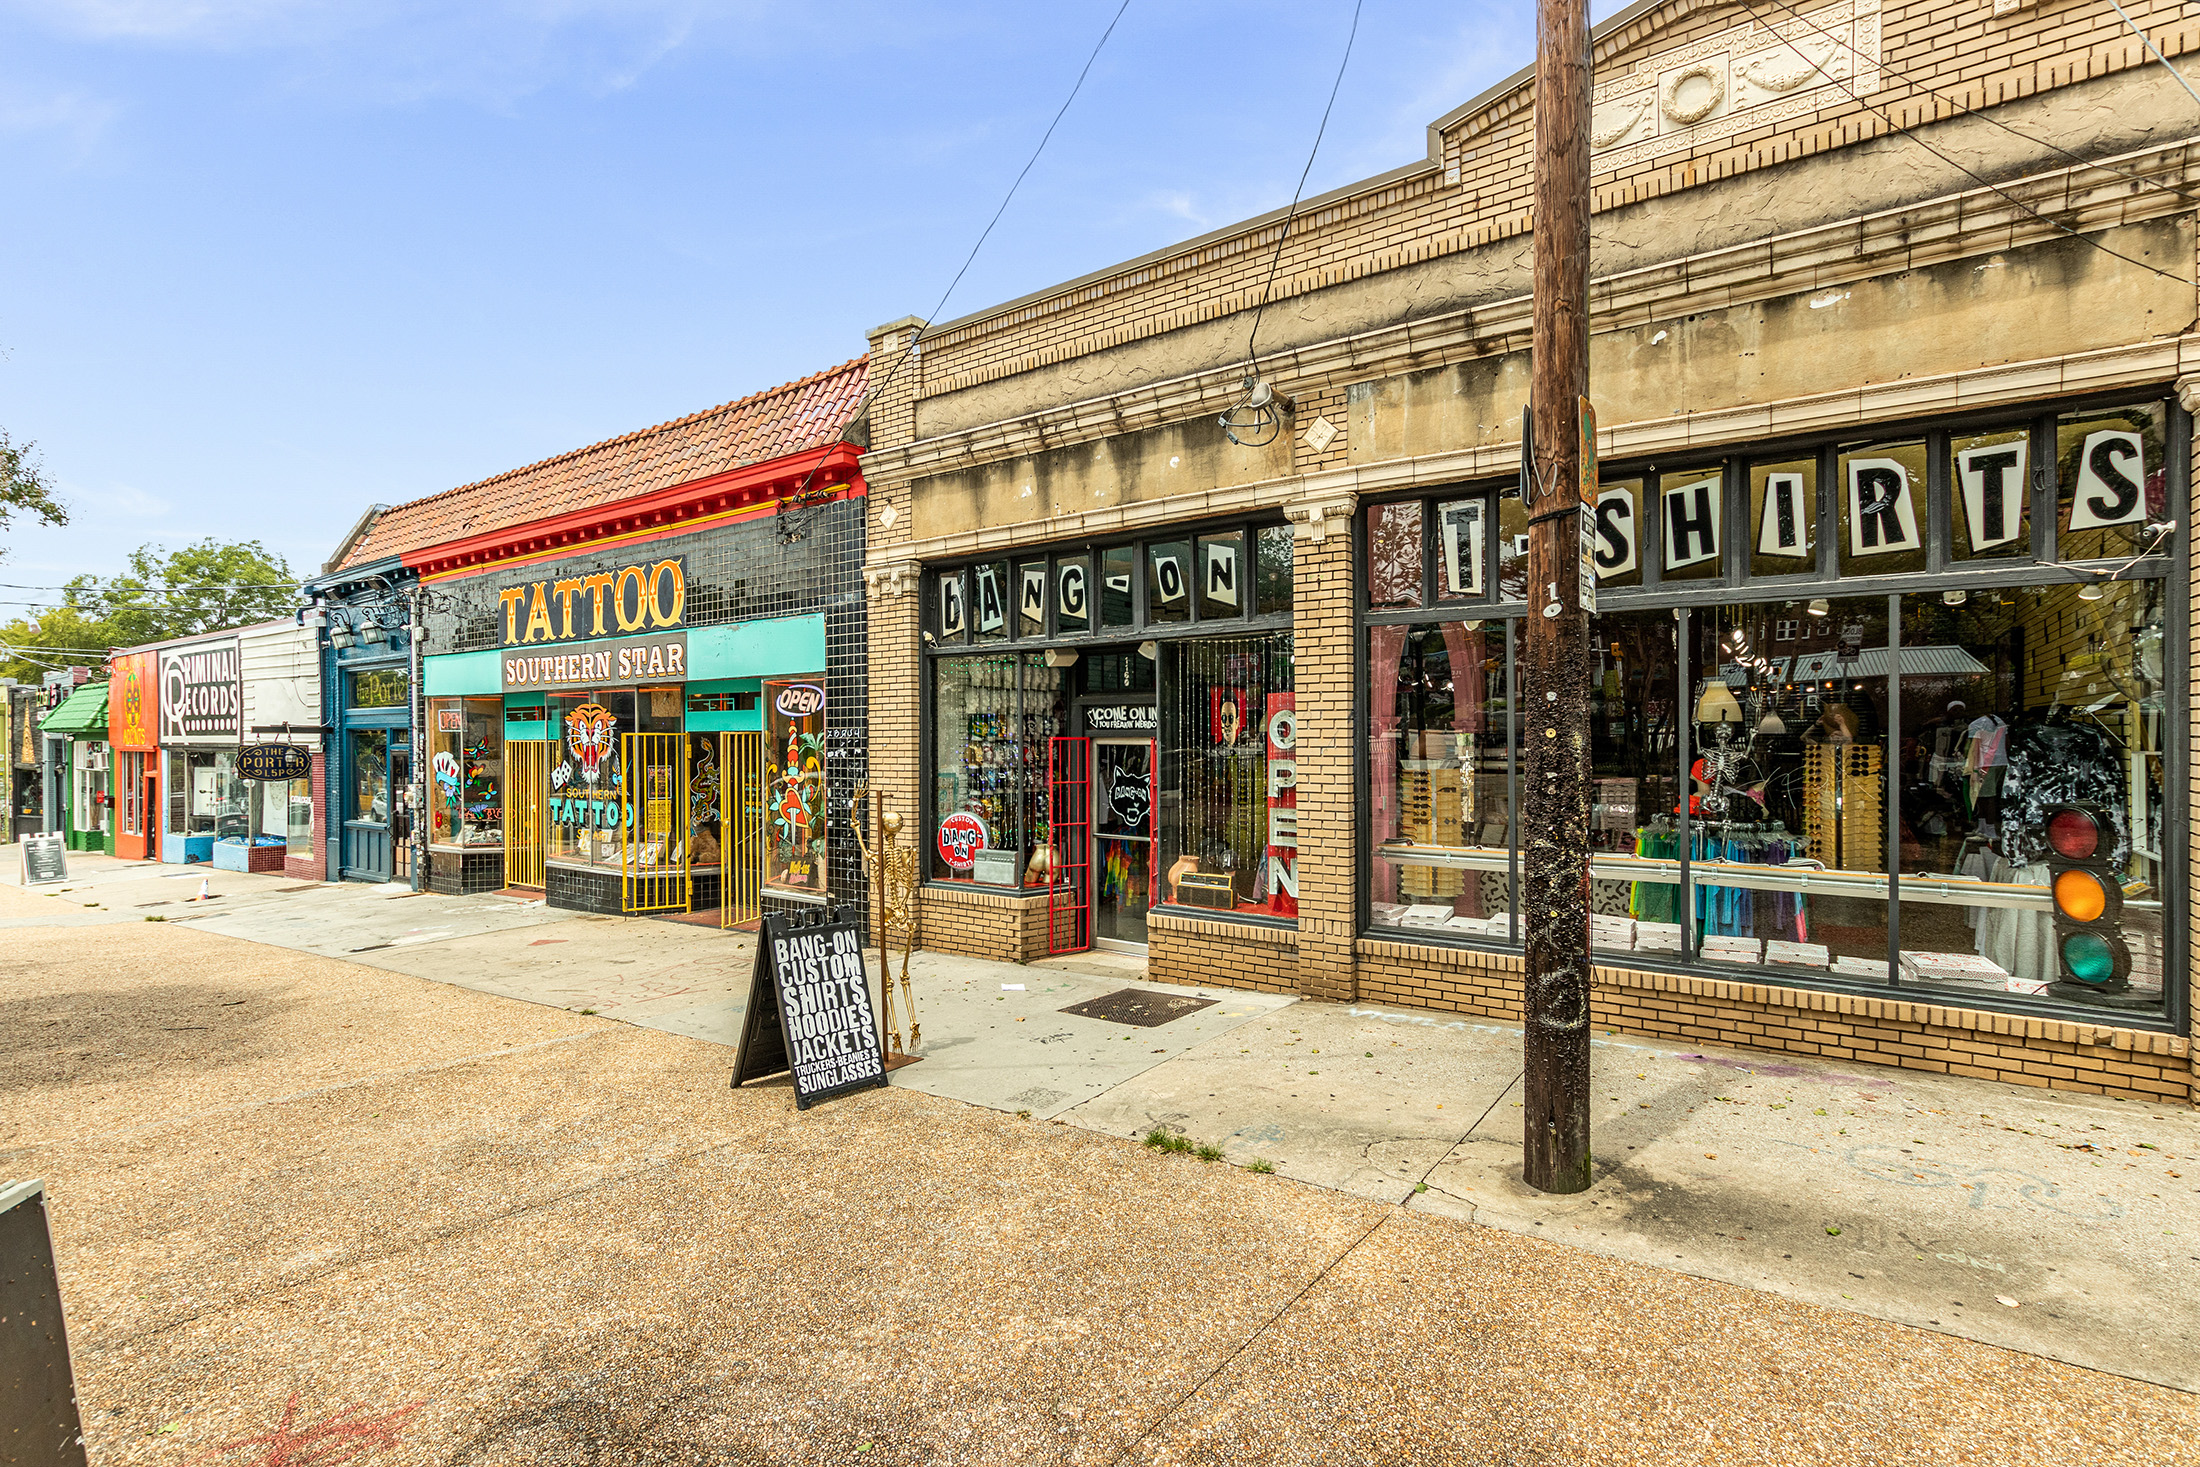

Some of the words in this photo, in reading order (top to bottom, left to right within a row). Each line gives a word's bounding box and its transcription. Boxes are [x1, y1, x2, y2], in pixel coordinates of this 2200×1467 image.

[498, 557, 685, 645] TATTOO
[506, 651, 612, 686] SOUTHERN
[618, 643, 685, 679] STAR
[369, 675, 408, 705] Porte
[779, 689, 820, 713] OPEN
[1095, 706, 1127, 721] COME
[1129, 707, 1146, 720] ON
[243, 757, 304, 768] PORTR
[566, 787, 617, 800] SOUTHERN
[1268, 709, 1299, 898] OPEN
[950, 815, 975, 825] CUSTOM
[954, 845, 967, 858] ON
[774, 930, 858, 964] BANG-ON
[778, 953, 862, 988] CUSTOM
[783, 976, 867, 1017] SHIRTS
[788, 1003, 872, 1041] HOODIES
[793, 1025, 876, 1066] JACKETS
[871, 1047, 879, 1058] &
[798, 1057, 882, 1094] SUNGLASSES
